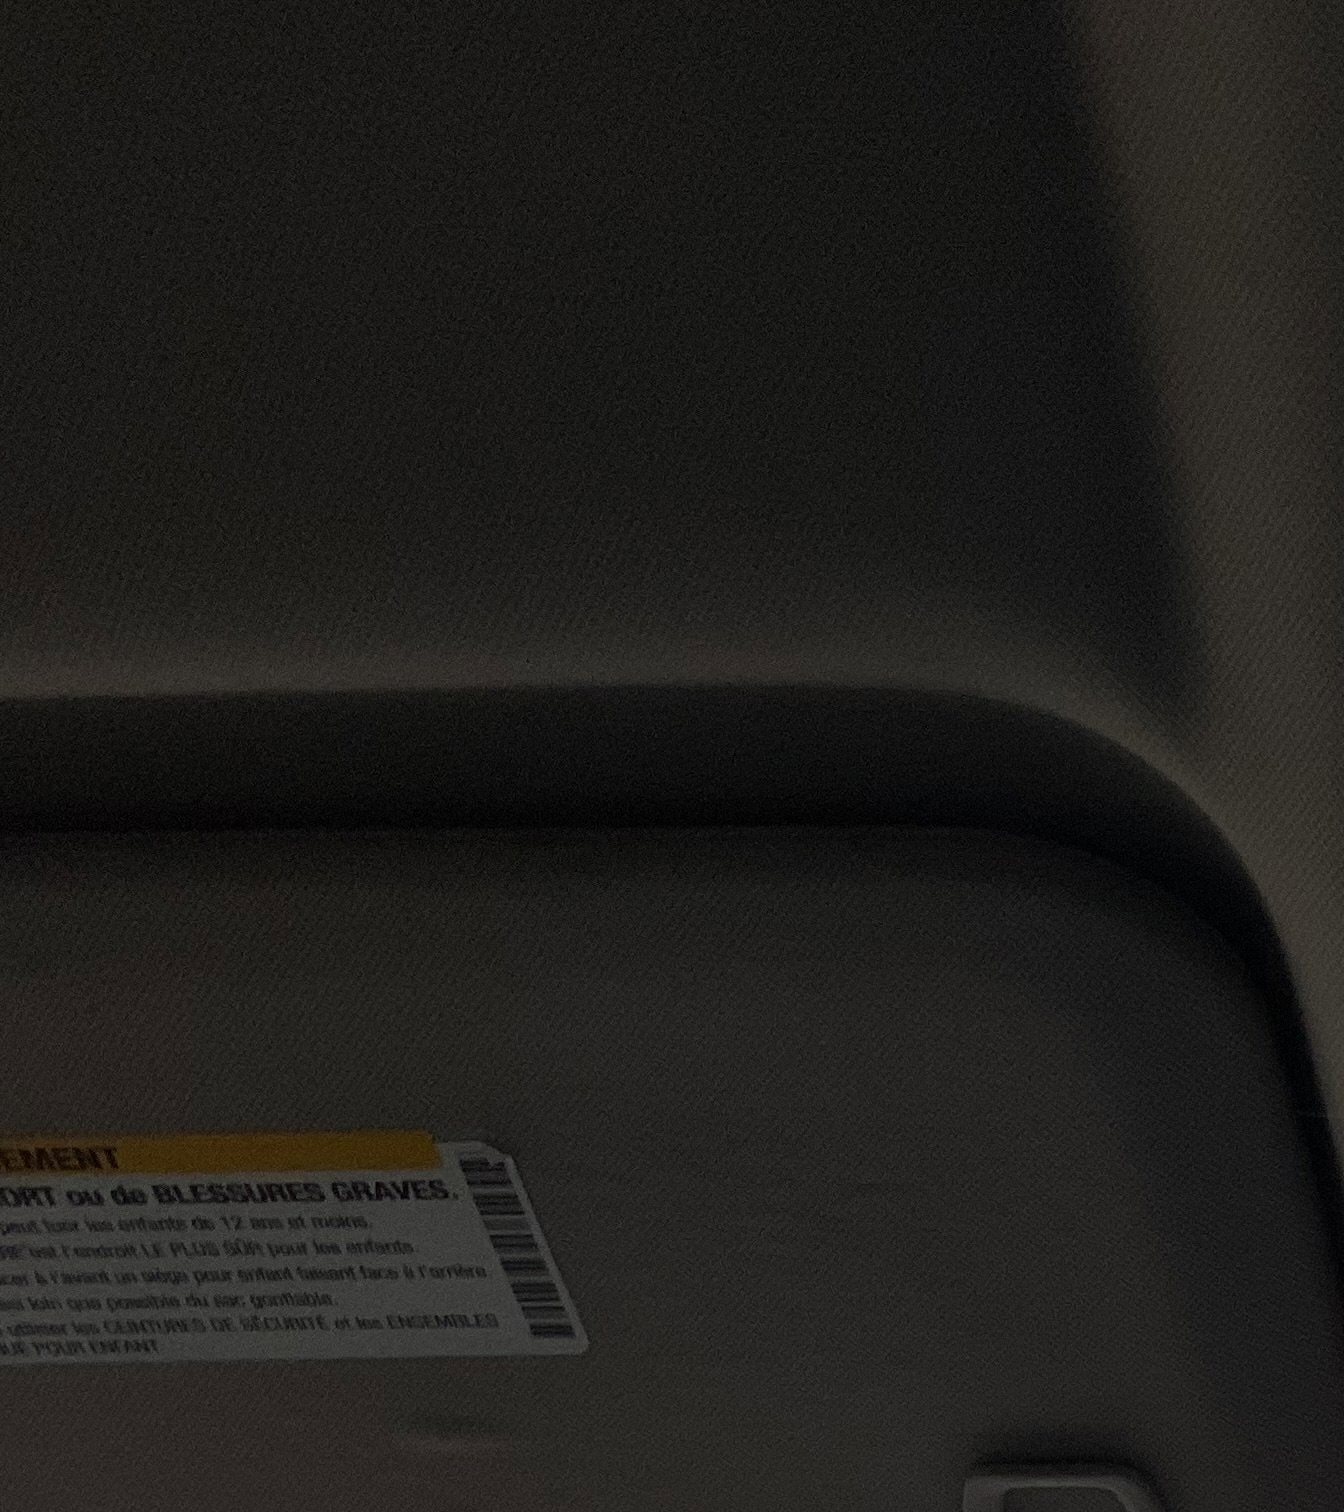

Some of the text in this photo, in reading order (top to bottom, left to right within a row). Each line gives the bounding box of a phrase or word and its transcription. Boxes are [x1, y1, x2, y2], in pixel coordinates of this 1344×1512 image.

[66, 1190, 104, 1206] ou
[110, 1185, 147, 1205] de
[151, 1181, 325, 1204] BLESSURES
[331, 1179, 458, 1202] GRAVES.
